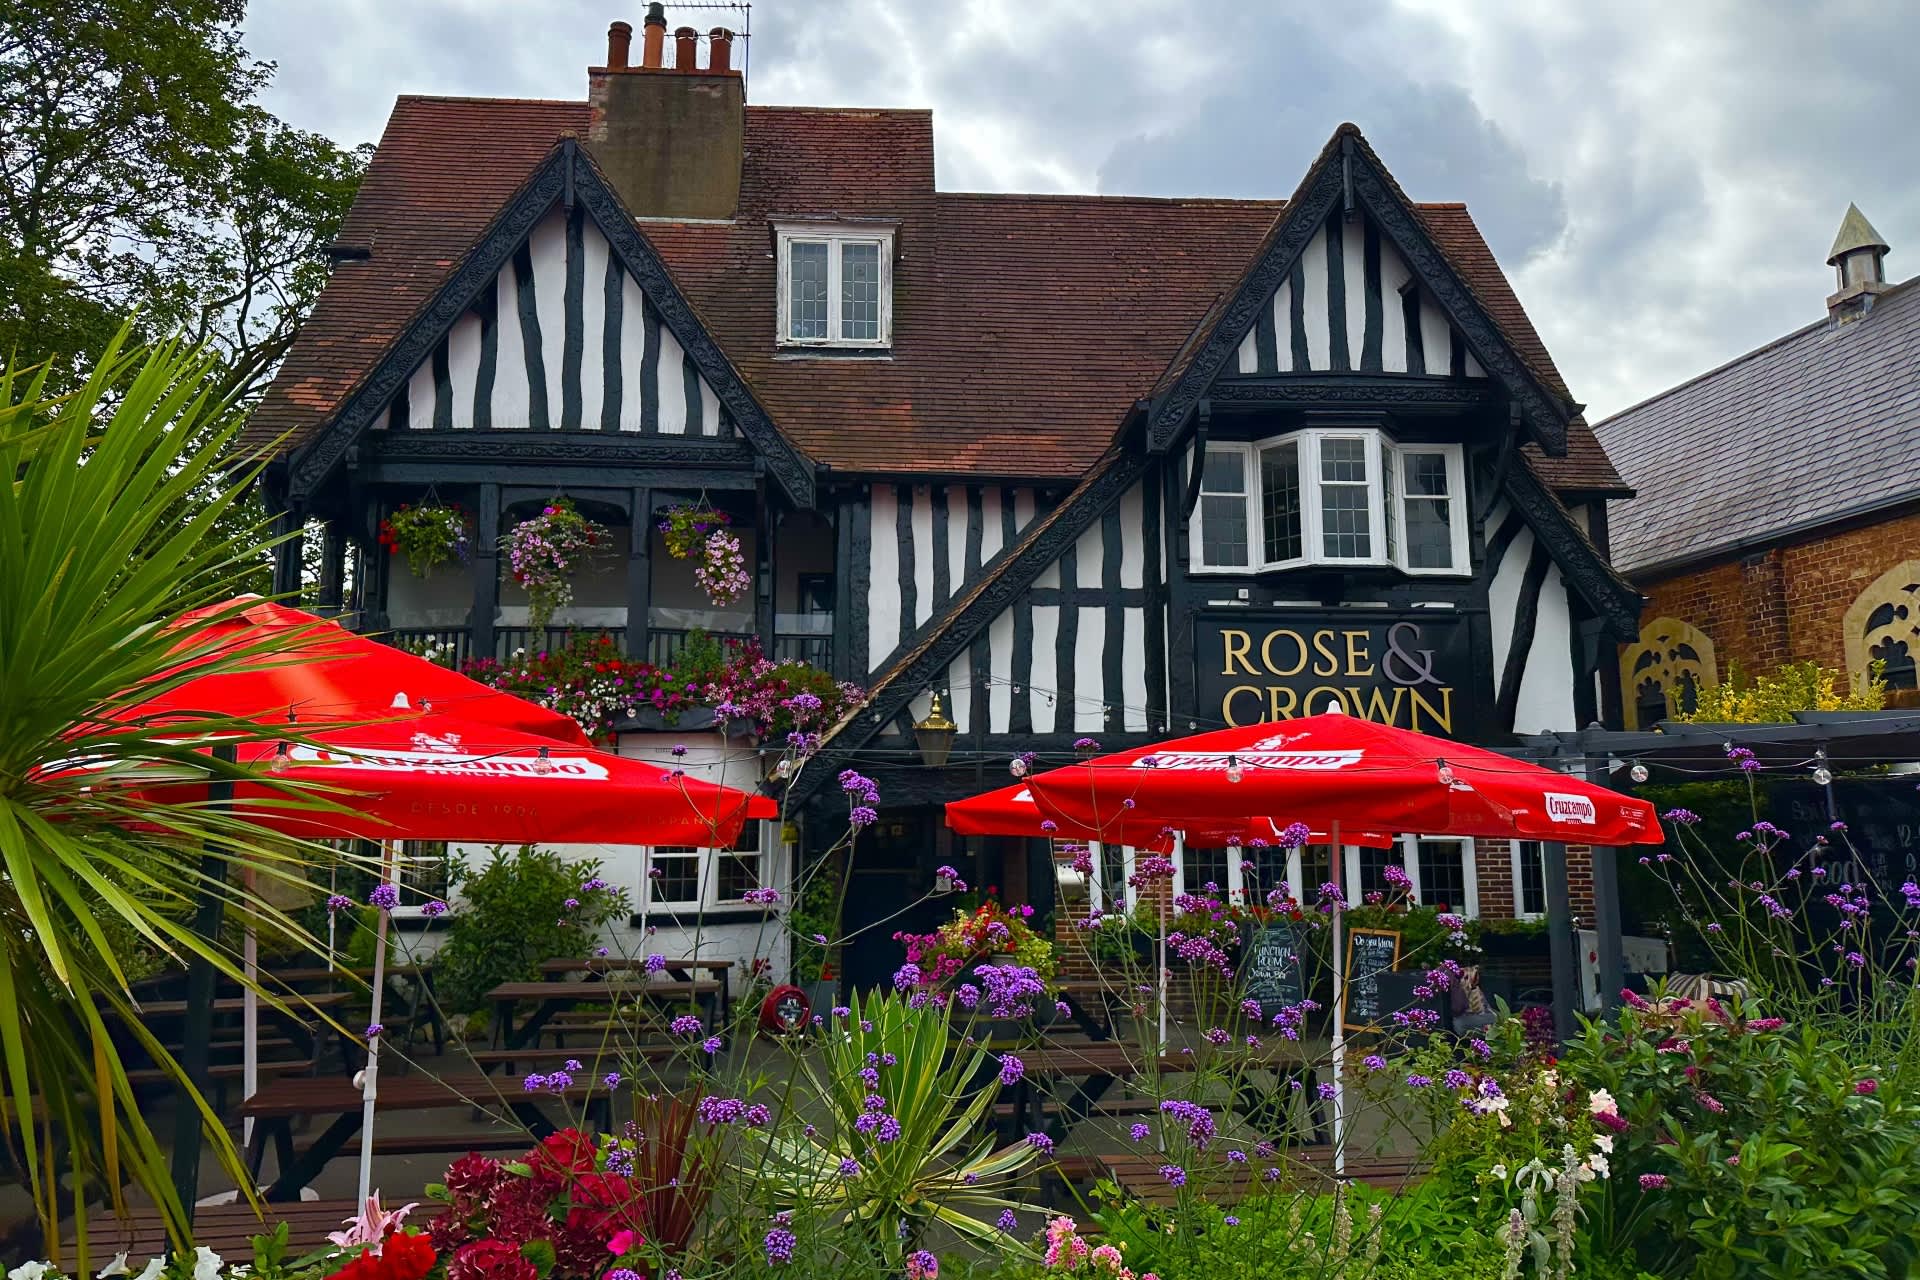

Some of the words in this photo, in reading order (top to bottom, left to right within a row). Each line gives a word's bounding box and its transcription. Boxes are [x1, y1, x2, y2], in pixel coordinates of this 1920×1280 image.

[1219, 629, 1375, 677] ROSE
[1381, 622, 1446, 686] &
[1549, 796, 1592, 819] Cruzcampo
